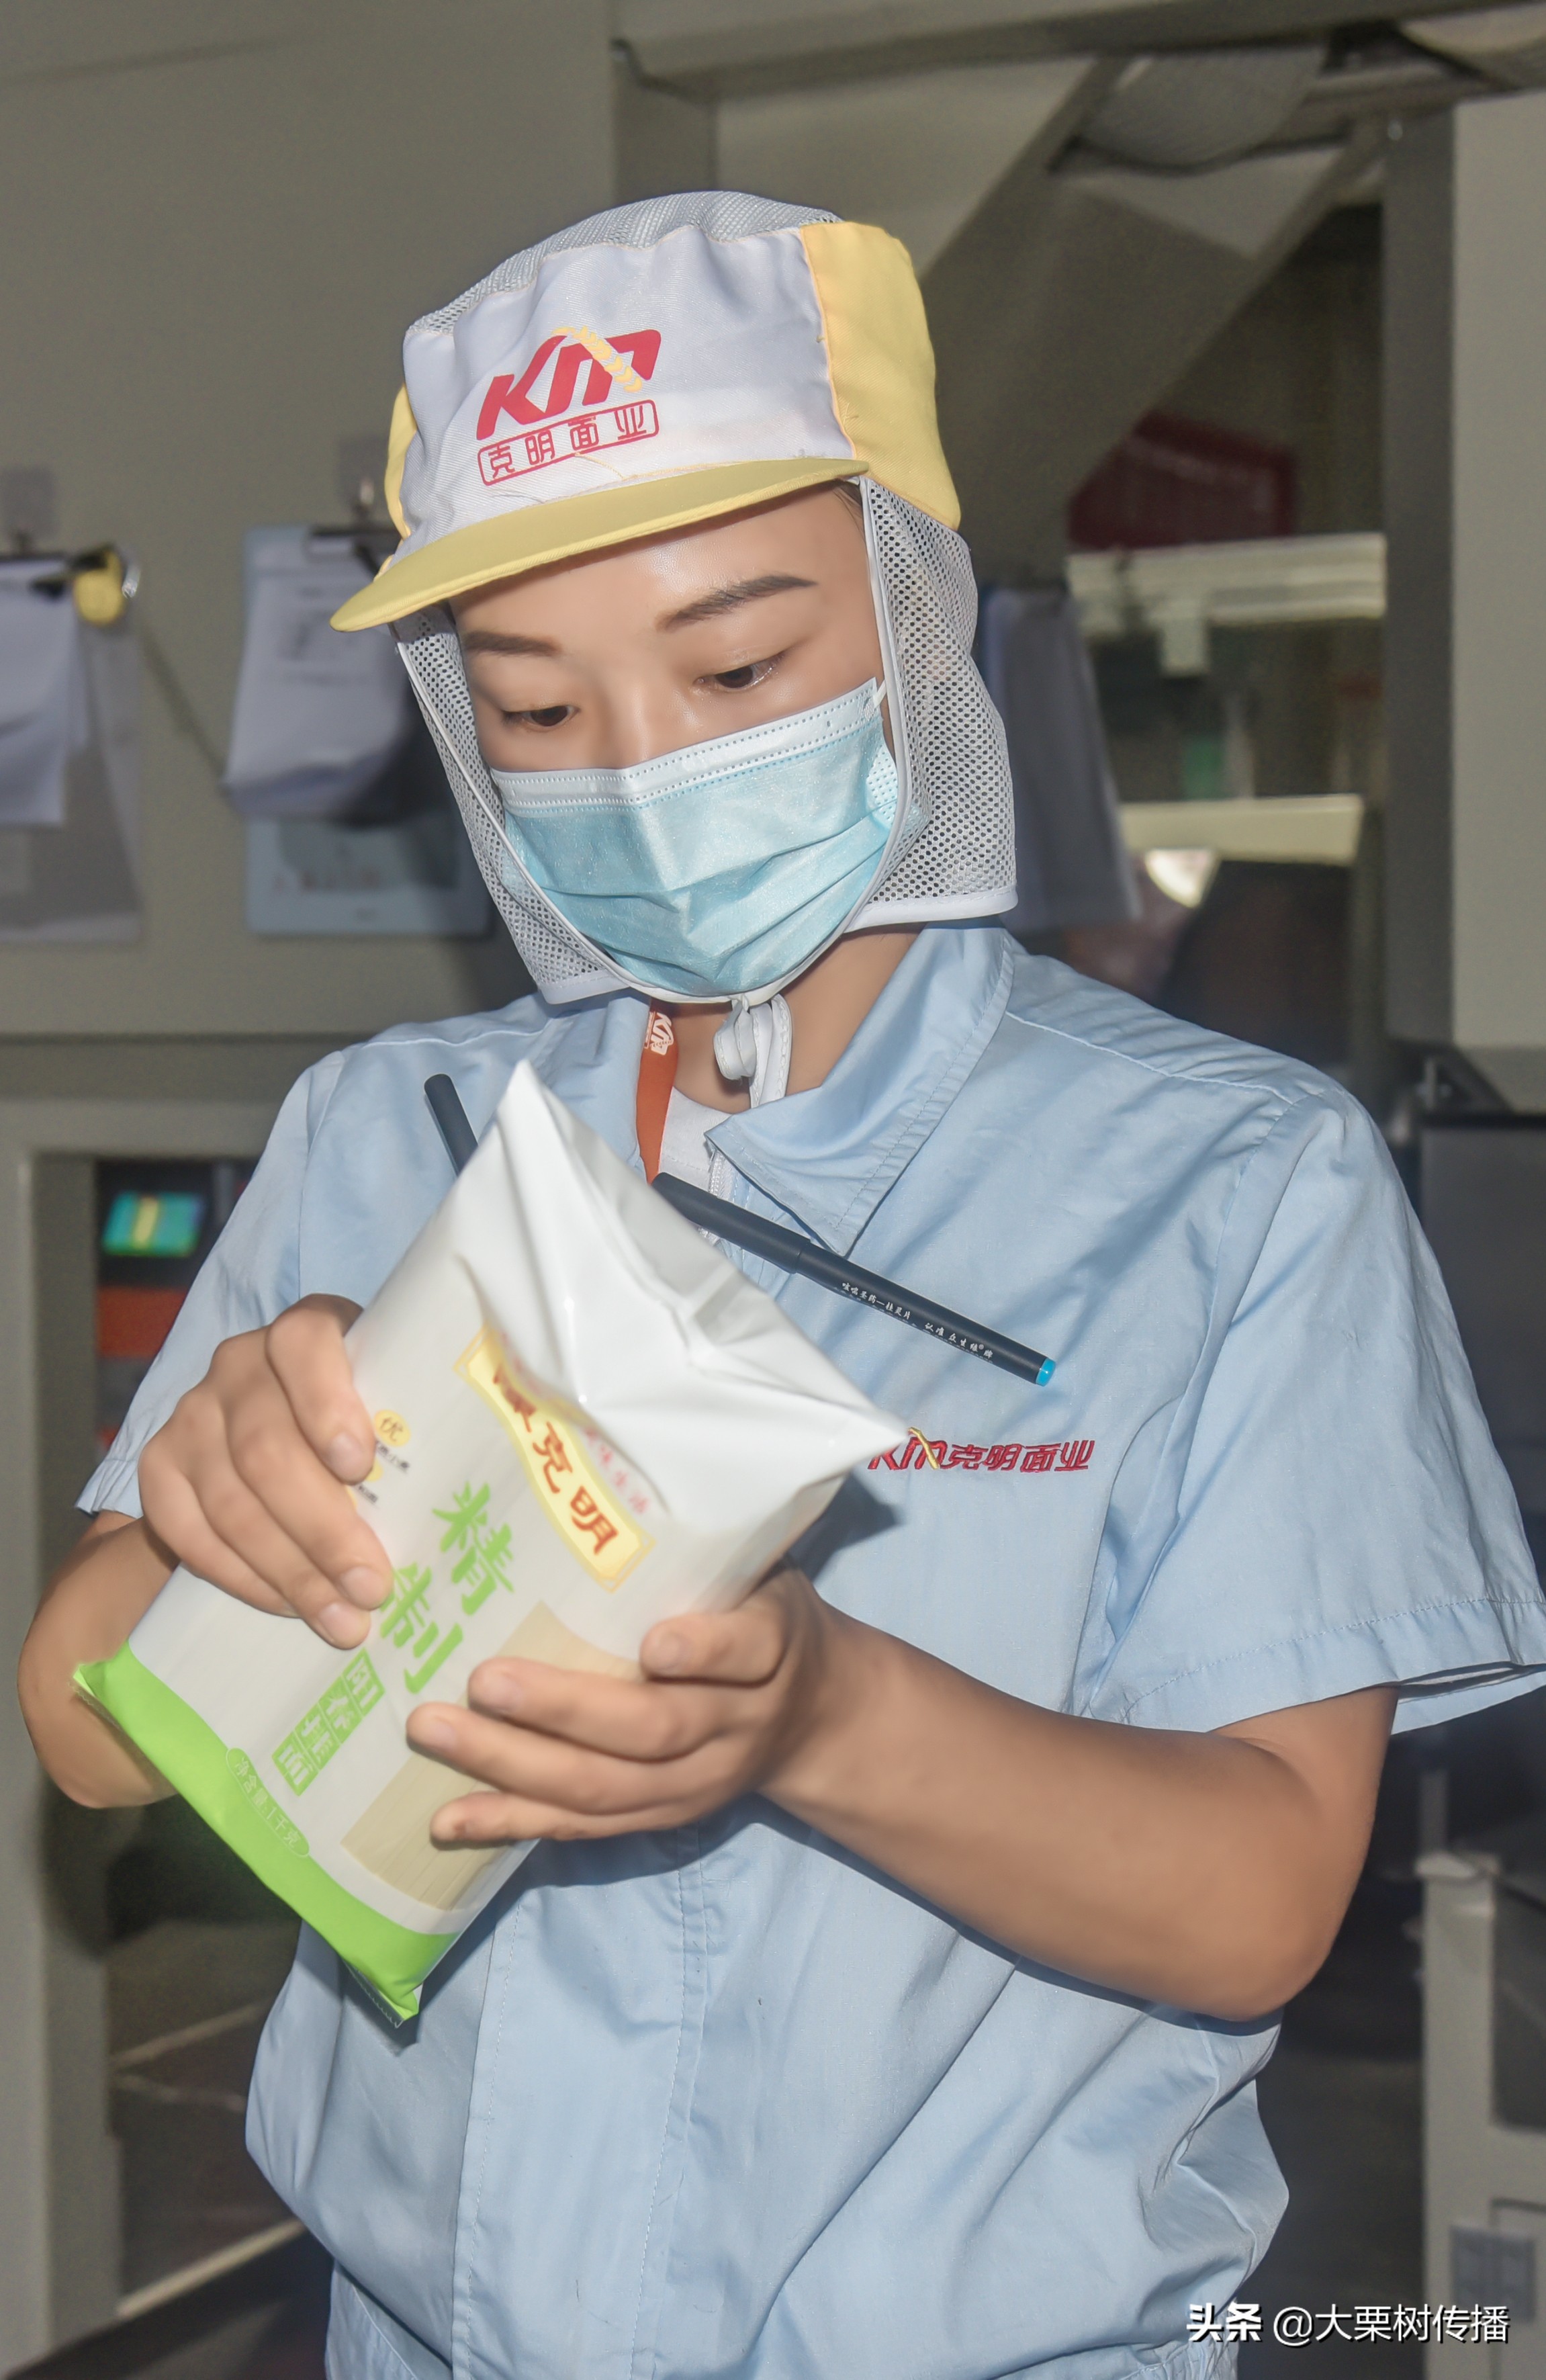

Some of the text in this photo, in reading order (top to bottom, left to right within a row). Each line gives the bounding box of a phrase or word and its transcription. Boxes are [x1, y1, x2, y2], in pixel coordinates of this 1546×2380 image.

[488, 404, 647, 480] 克明面业
[379, 1481, 515, 1694] 精制
